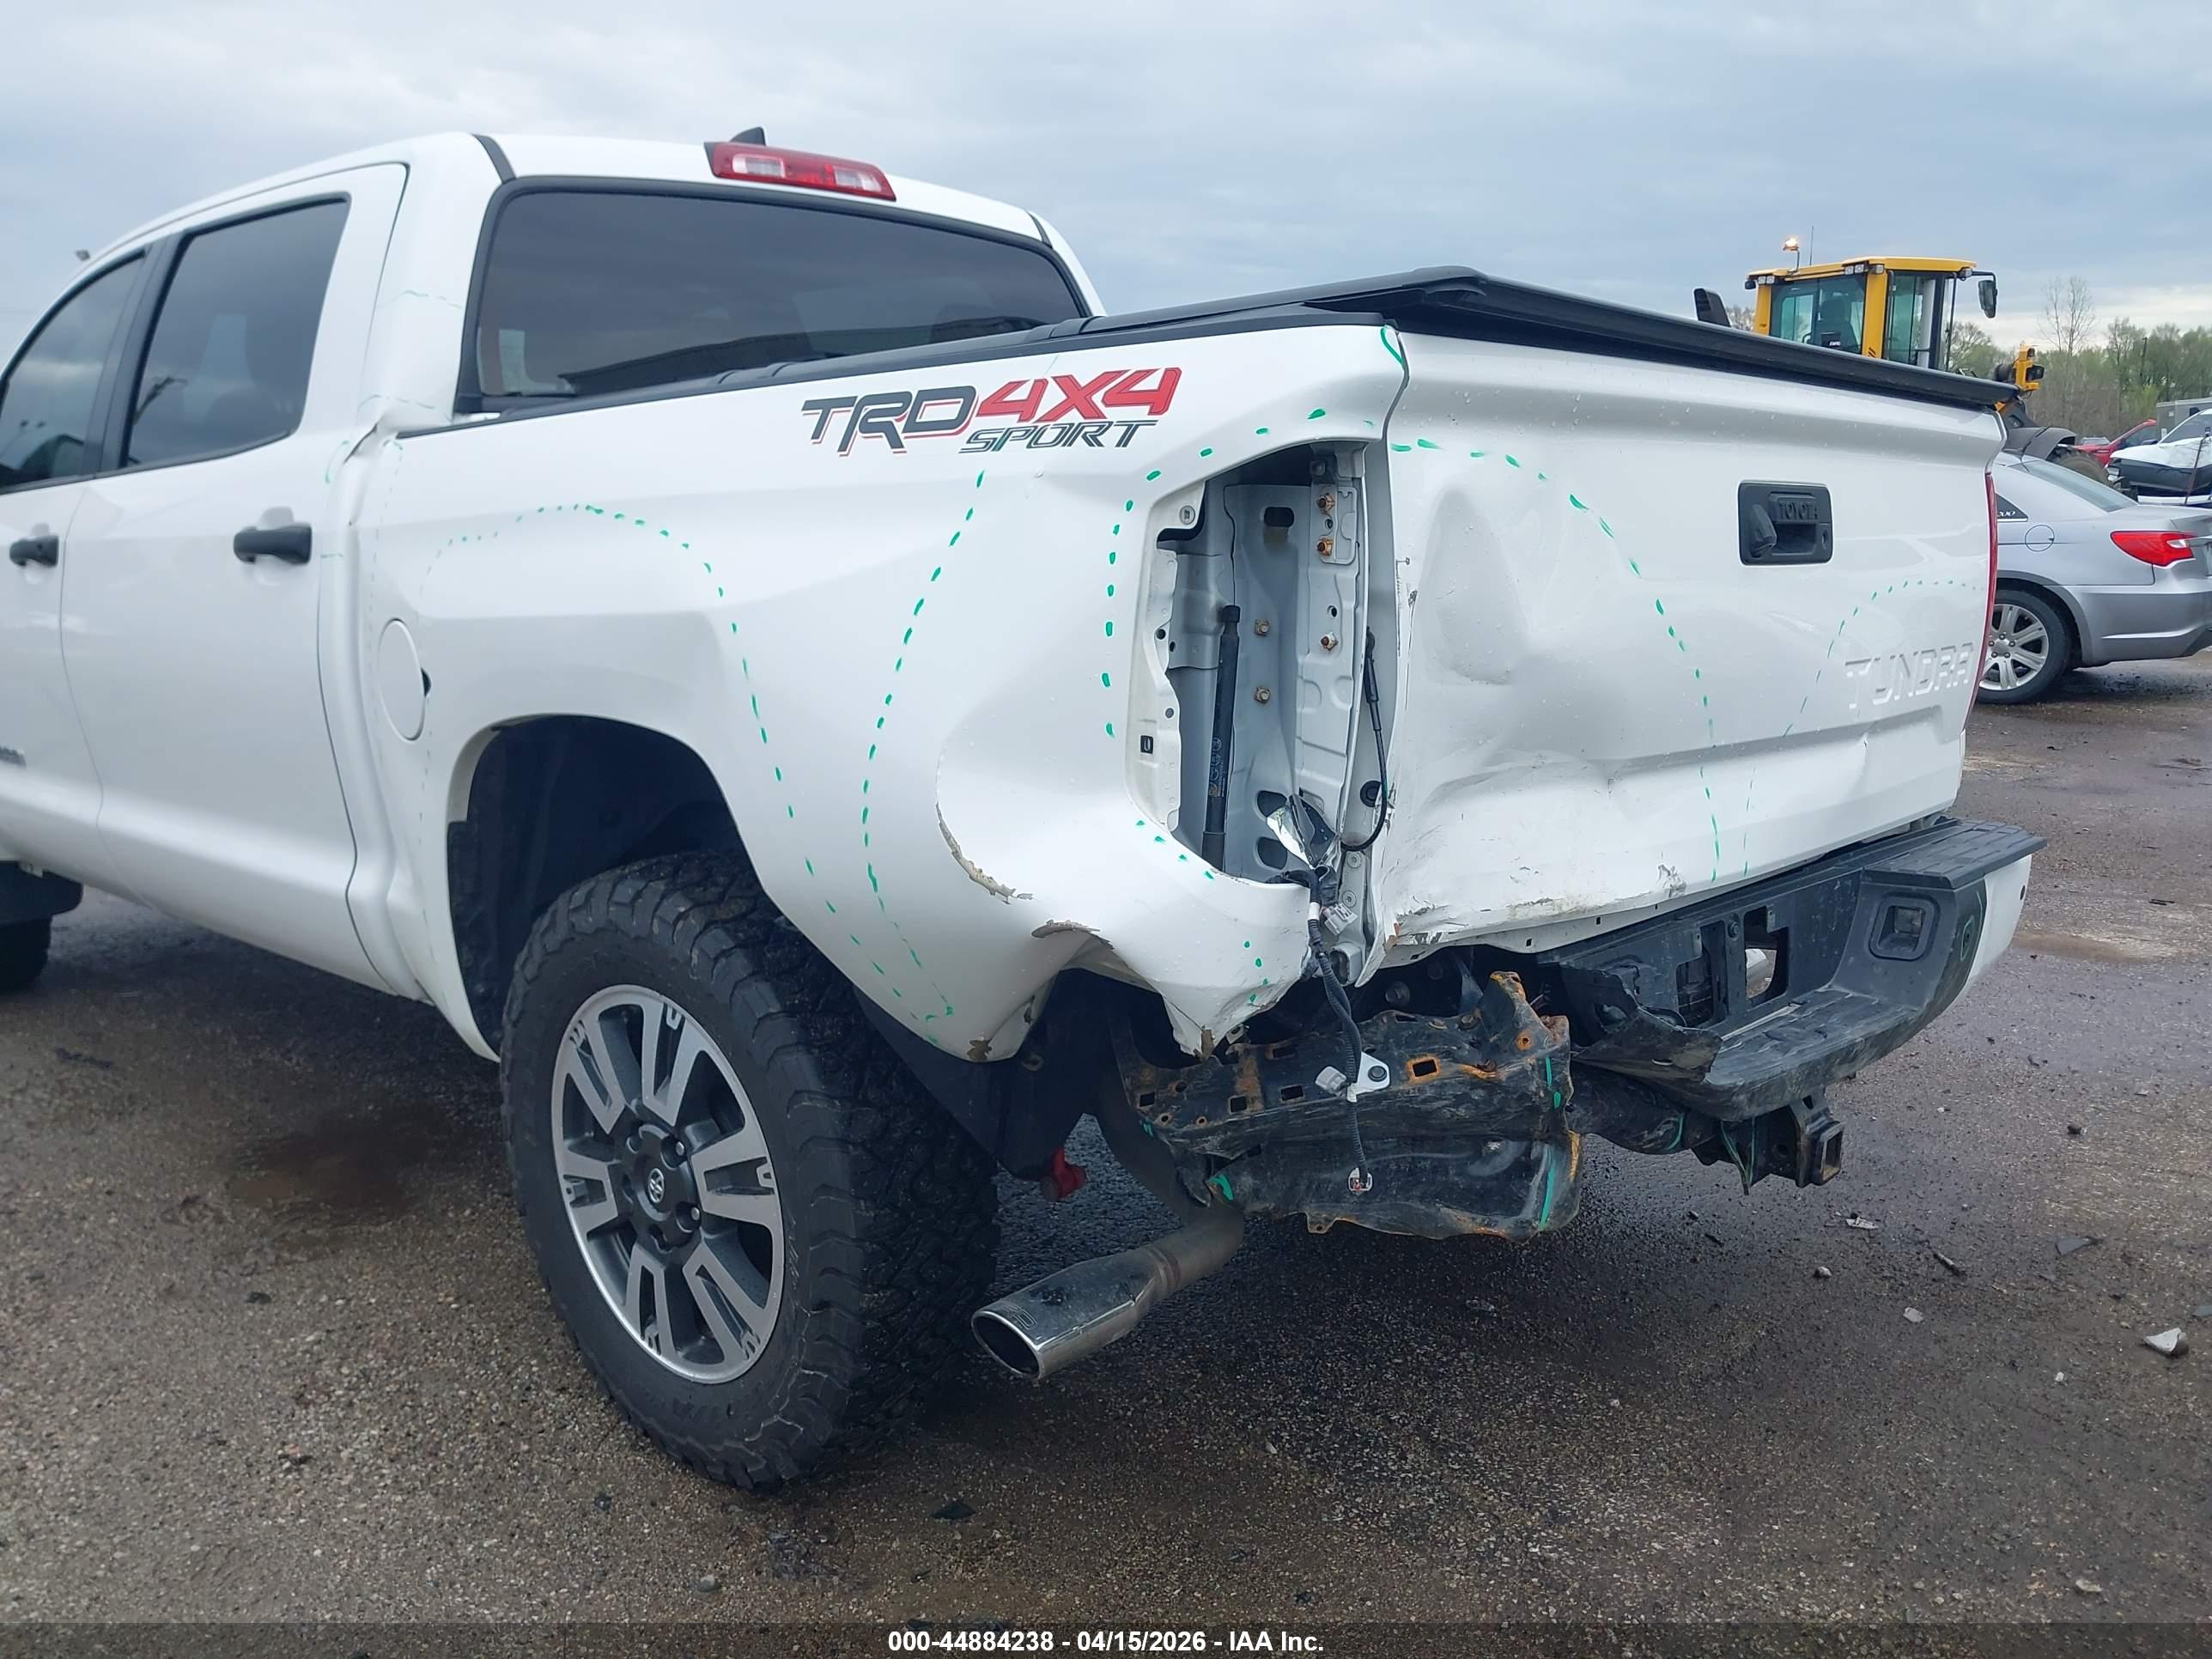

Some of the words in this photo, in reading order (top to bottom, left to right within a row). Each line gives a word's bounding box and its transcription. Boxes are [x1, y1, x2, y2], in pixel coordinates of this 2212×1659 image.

[800, 385, 977, 457] TRD
[957, 419, 1159, 454] SPORT
[1778, 501, 1818, 520] TOYOTA
[1844, 643, 1974, 709] TUNDRA
